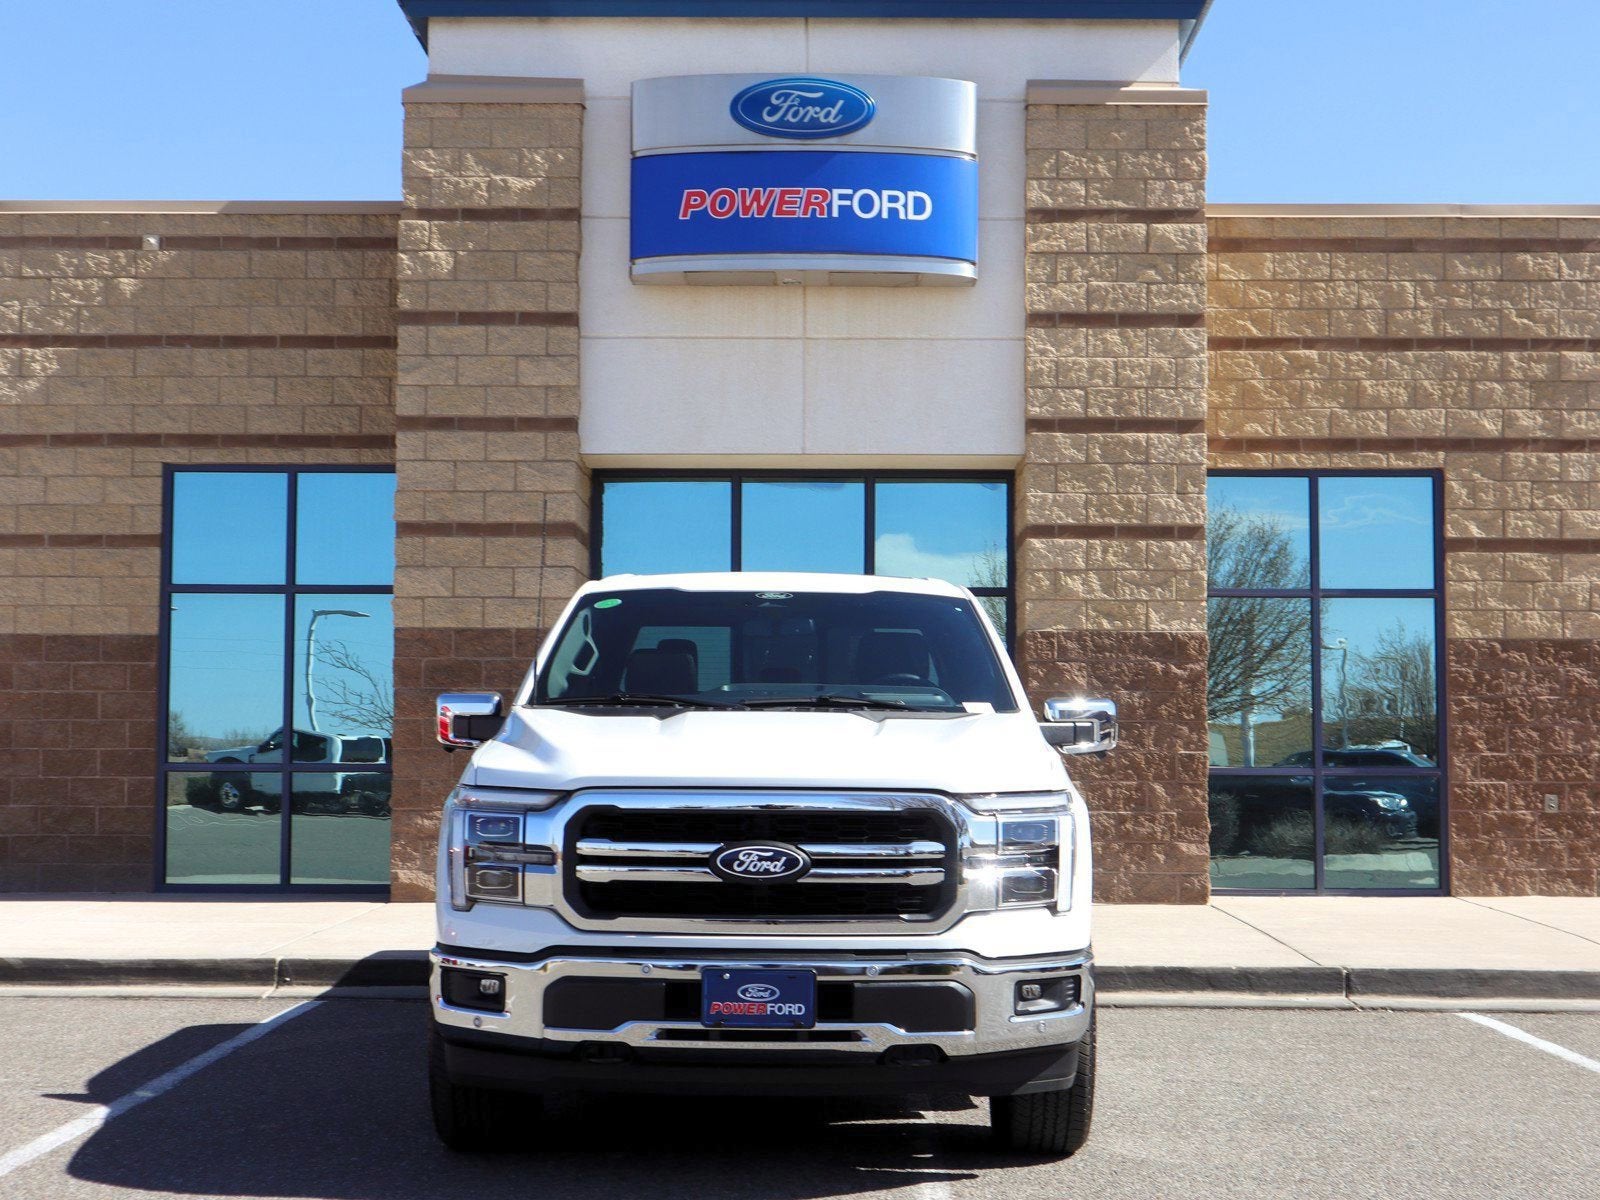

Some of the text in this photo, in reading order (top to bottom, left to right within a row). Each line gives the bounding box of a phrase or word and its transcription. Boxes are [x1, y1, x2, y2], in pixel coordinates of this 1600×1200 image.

[762, 89, 843, 124] Ford
[733, 850, 785, 872] Ford
[745, 987, 772, 998] Ford
